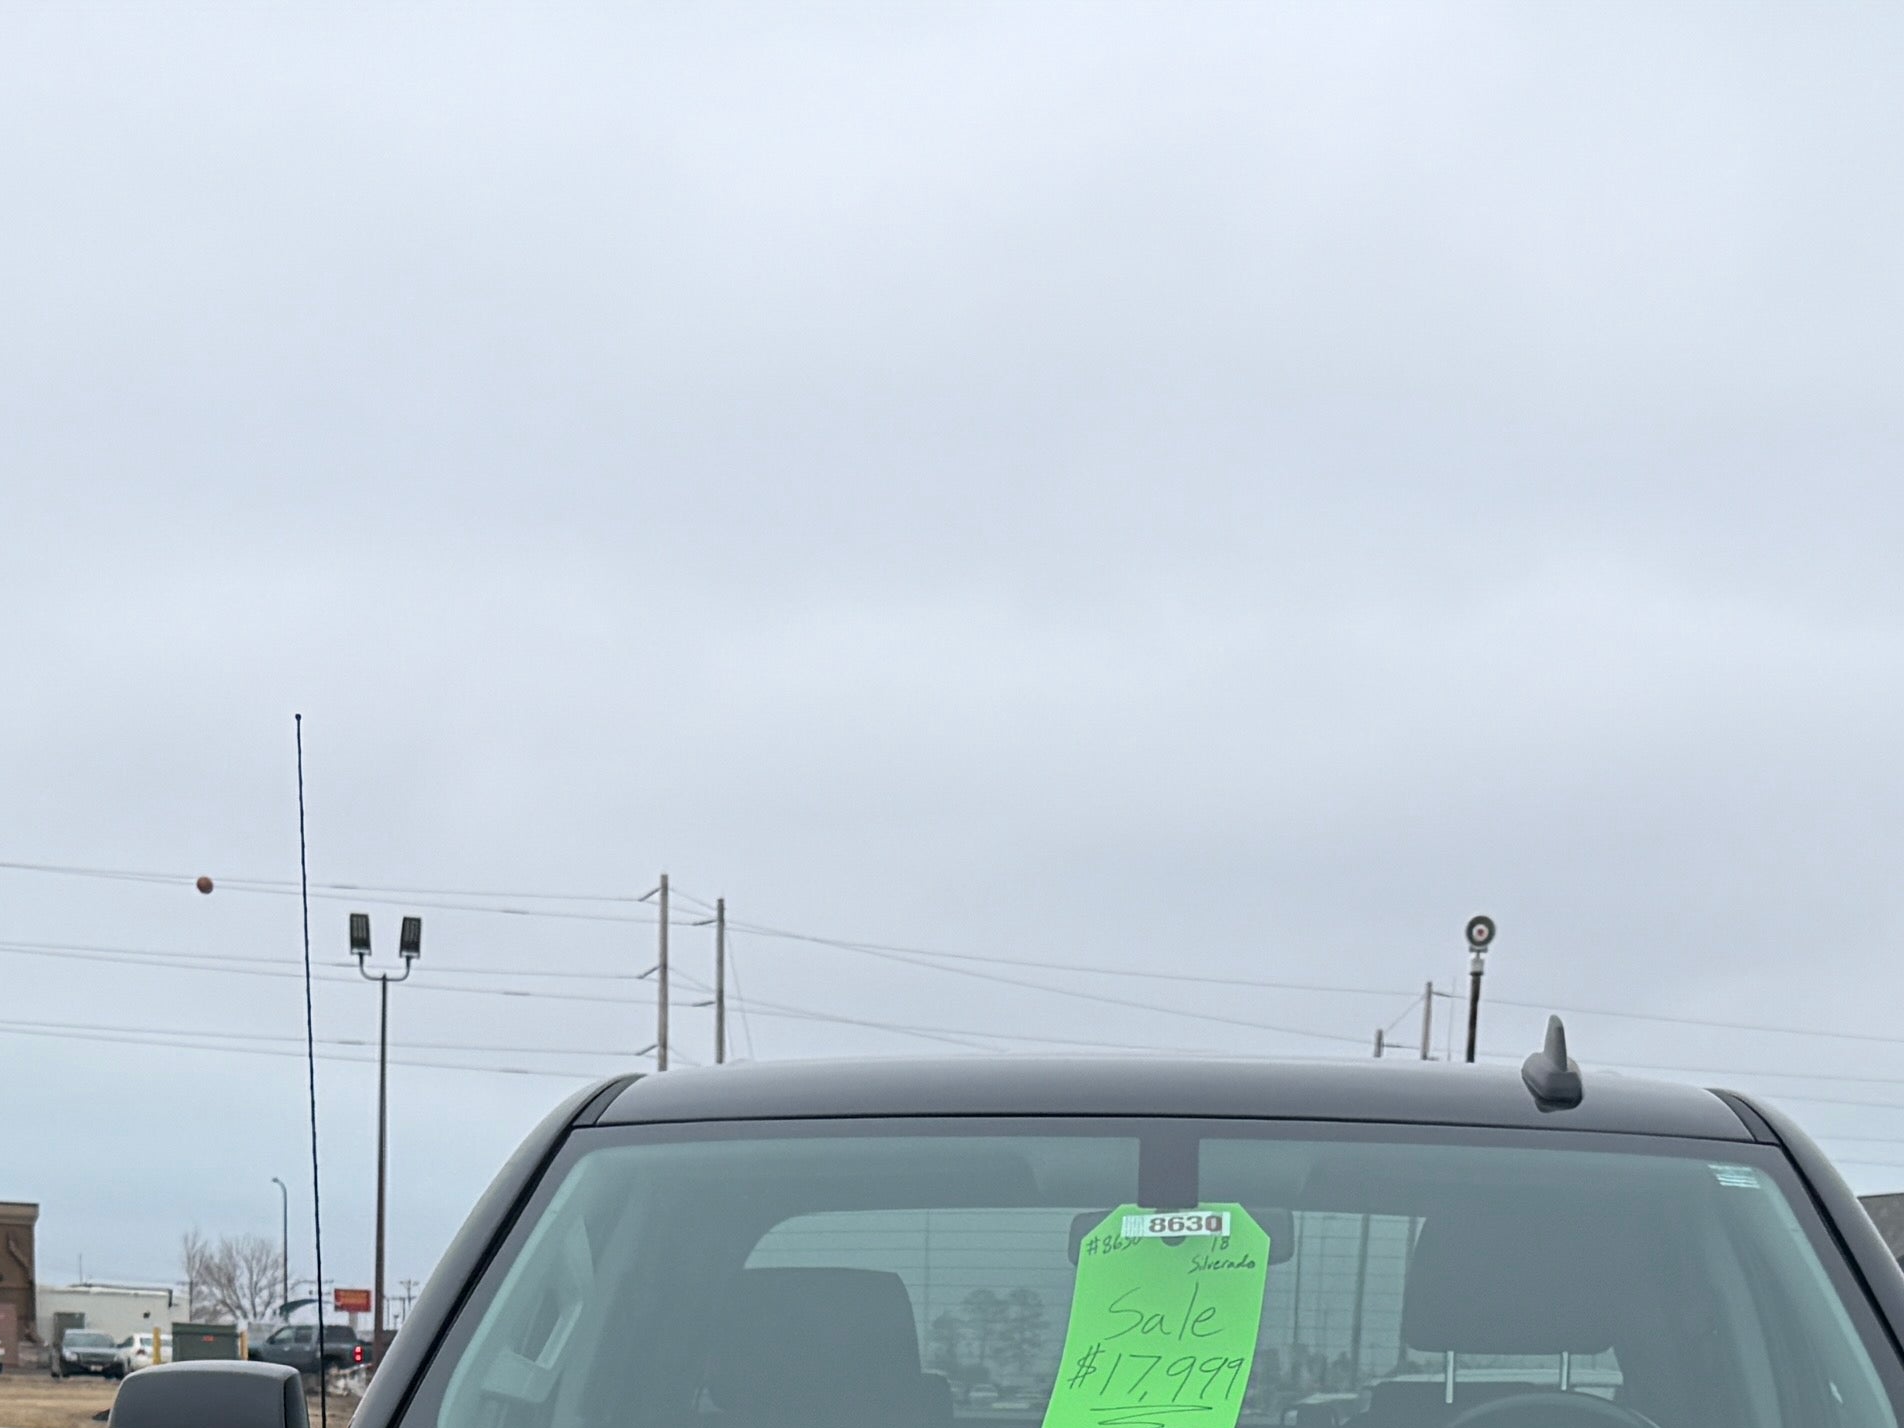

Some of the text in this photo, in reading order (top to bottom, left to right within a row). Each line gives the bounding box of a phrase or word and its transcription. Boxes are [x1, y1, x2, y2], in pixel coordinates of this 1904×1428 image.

[1149, 1215, 1223, 1233] 8630
[1187, 1254, 1256, 1275] Silverado
[1104, 1281, 1226, 1341] Sale
[1067, 1343, 1246, 1403] $17,999
